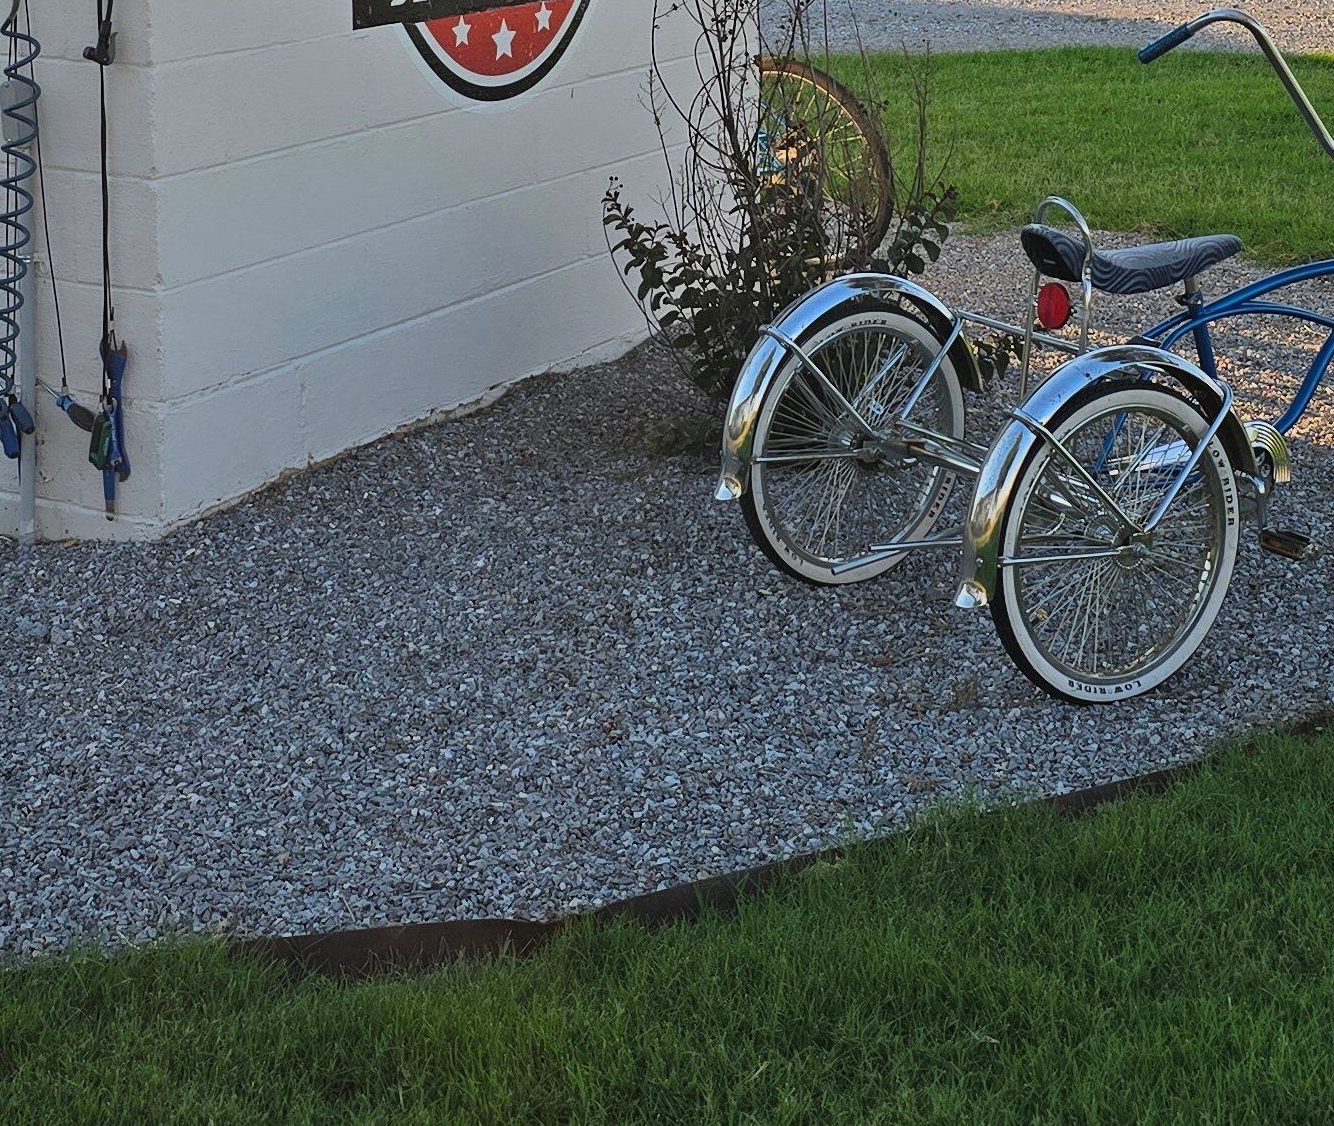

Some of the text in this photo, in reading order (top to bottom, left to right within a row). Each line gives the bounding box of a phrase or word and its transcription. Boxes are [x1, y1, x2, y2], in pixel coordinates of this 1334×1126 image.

[1208, 440, 1235, 526] LOW RIDER
[1068, 679, 1142, 695] LOW RIDER
